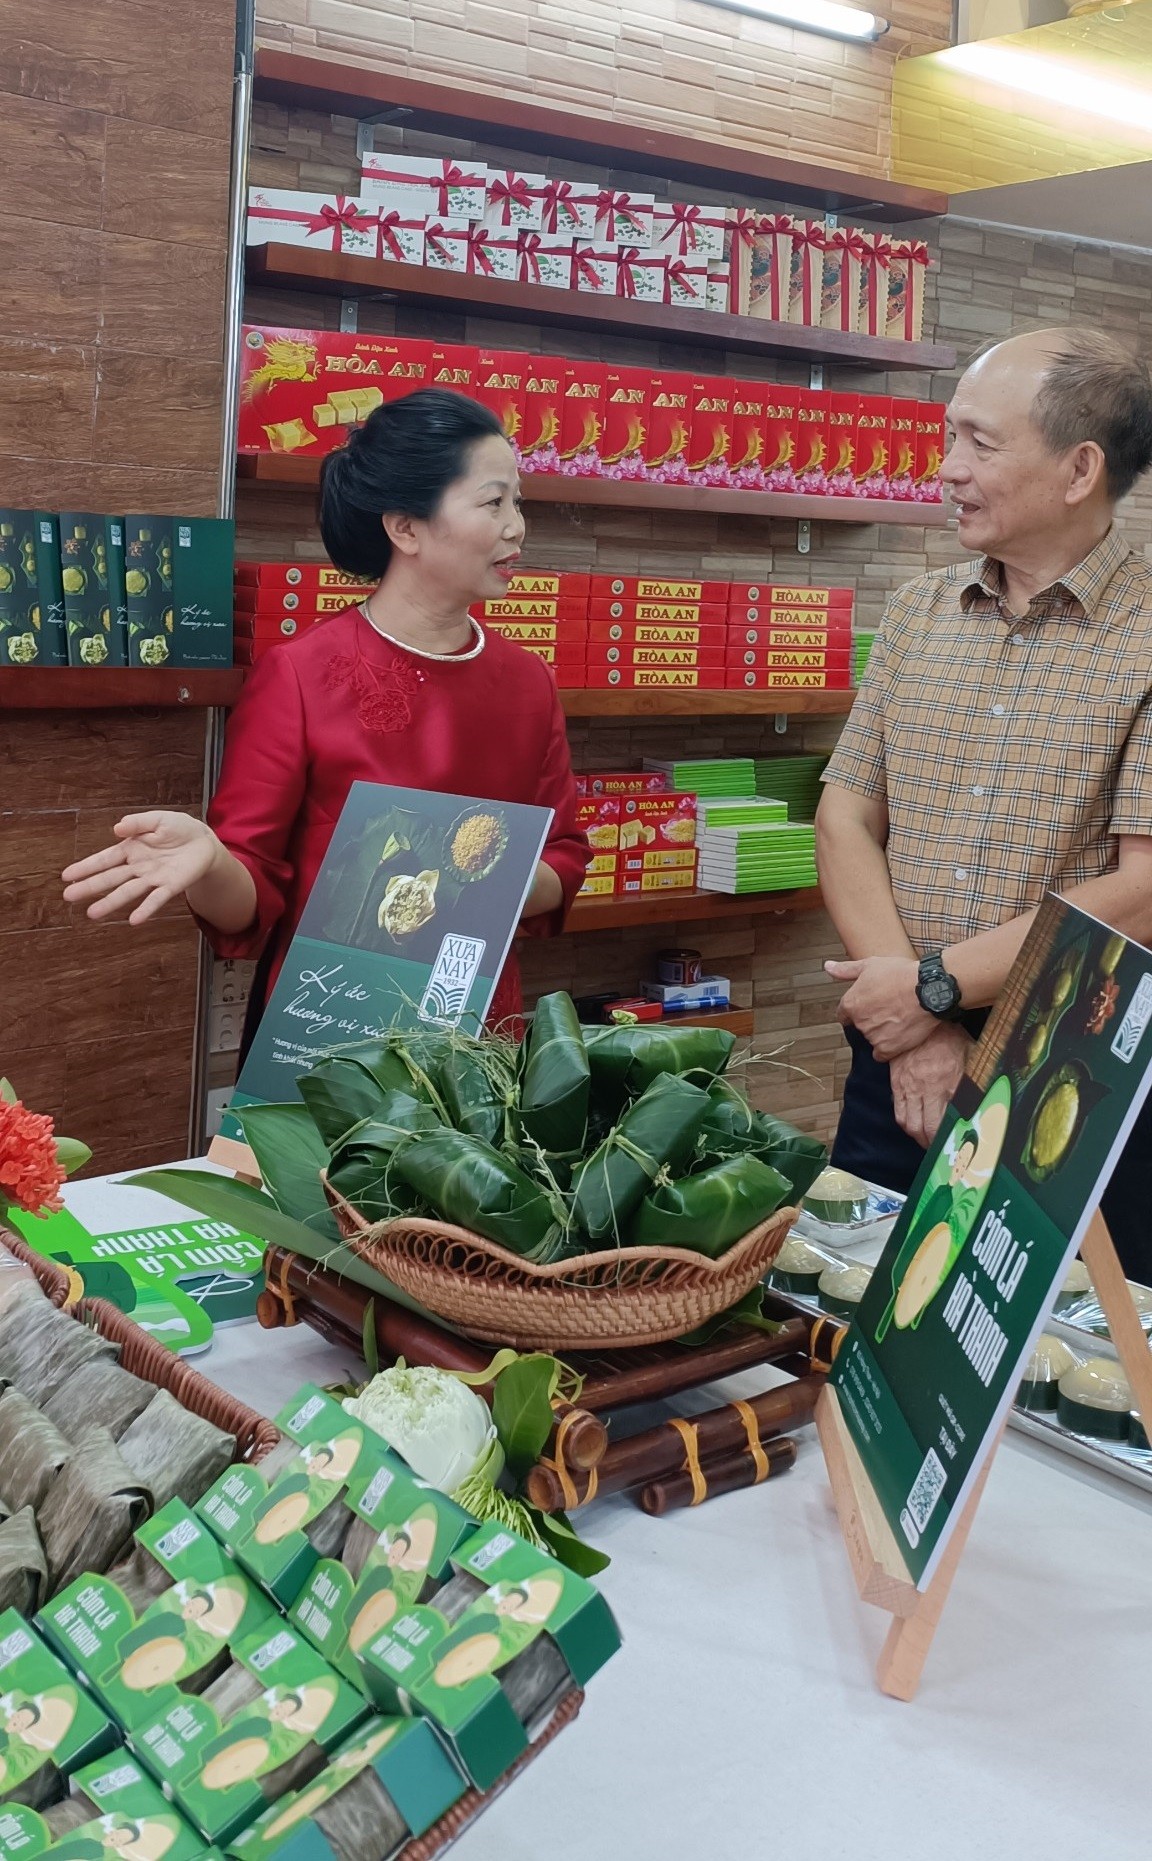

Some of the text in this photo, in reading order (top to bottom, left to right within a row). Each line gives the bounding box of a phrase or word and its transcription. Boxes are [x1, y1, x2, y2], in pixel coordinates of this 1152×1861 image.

[326, 353, 427, 379] HÒA AN
[434, 367, 472, 384] AN
[484, 373, 521, 389] AN
[526, 377, 559, 393] AN
[565, 383, 601, 398] AN
[610, 388, 645, 403] AN
[653, 393, 687, 408] AN
[695, 397, 729, 412] AN
[733, 401, 763, 416] AN
[767, 405, 795, 420] AN
[798, 409, 826, 422] AN
[858, 415, 887, 428] AN
[530, 581, 554, 592] AN
[642, 583, 697, 598] HÒA AN
[775, 589, 825, 603] HÒA AN
[490, 602, 551, 615] HÒA AN
[640, 606, 695, 620] HÒA AN
[774, 610, 824, 624] HÒA AN
[527, 628, 551, 638] AN
[640, 628, 694, 642] HÒA AN
[773, 632, 823, 645] HÒA AN
[637, 650, 692, 663] HÒA AN
[771, 653, 821, 665] HÒA AN
[639, 671, 694, 684] HÒA AN
[772, 673, 822, 686] HÒA AN
[606, 780, 625, 789] HÒA
[639, 800, 659, 809] HÒA
[444, 939, 476, 961] XƯA
[438, 957, 474, 979] NAY
[295, 964, 348, 1007] Ký
[443, 978, 459, 986] 1932
[283, 991, 338, 1034] hương
[338, 1020, 360, 1034] vị
[90, 1228, 195, 1257] THÀNH
[972, 1199, 1034, 1303] CỐM LÁ
[135, 1241, 263, 1278] CỐM LÁ
[942, 1270, 1009, 1388] HÀ THÀNH
